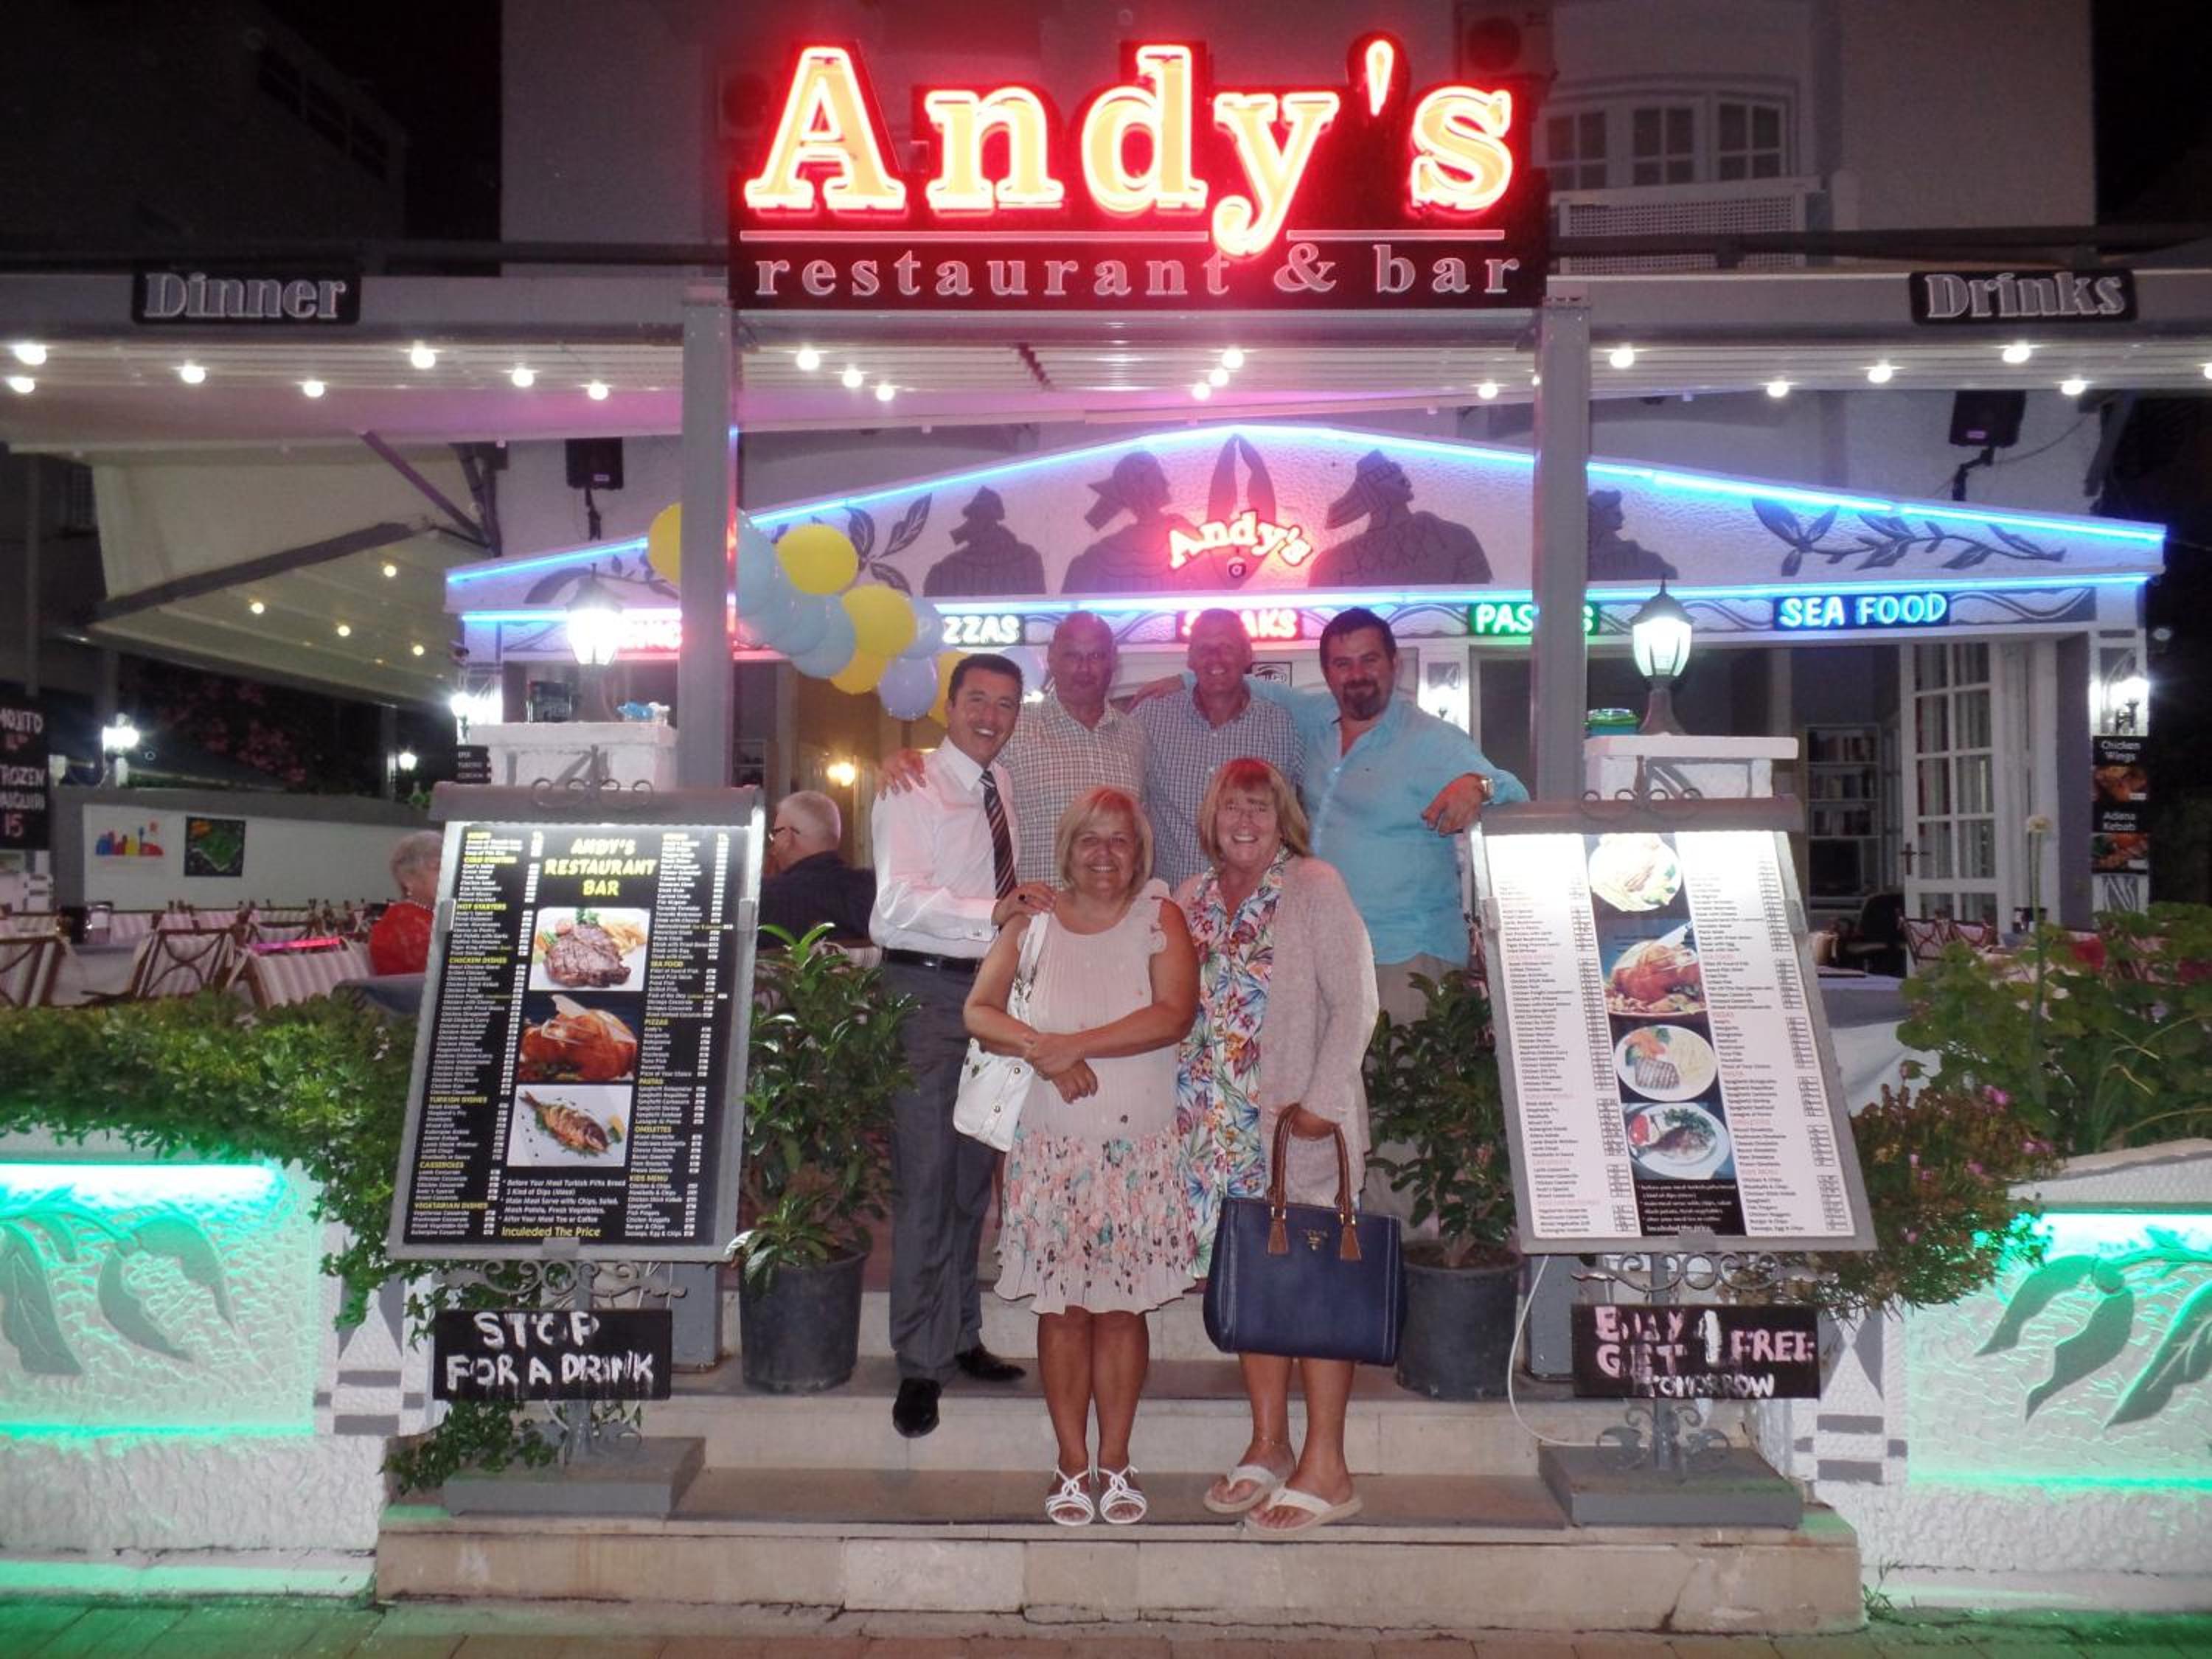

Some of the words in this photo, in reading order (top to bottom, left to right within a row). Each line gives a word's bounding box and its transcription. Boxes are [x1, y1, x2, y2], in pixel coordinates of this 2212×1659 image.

[743, 38, 1514, 257] Andy's
[754, 248, 1231, 296] restaurant
[1273, 242, 1335, 294] &
[1374, 243, 1520, 295] bar
[143, 271, 347, 319] Dinner
[1924, 271, 2125, 319] Drinks
[1169, 510, 1312, 569] Andy's
[1778, 596, 1846, 627] SEA
[1856, 593, 1947, 625] FOOD
[942, 615, 1020, 644] ZZAS
[0, 764, 46, 786] ROZEN
[571, 838, 636, 856] ANDY'S
[544, 858, 657, 875] RESTAURANT
[582, 879, 619, 896] BAR
[555, 1227, 573, 1237] The
[576, 1227, 601, 1237] Price
[473, 1311, 600, 1350] STOP
[1694, 1309, 1722, 1364] 1
[1731, 1329, 1816, 1363] FREE
[446, 1354, 520, 1392] FOR
[529, 1356, 552, 1386] A
[561, 1350, 655, 1388] DRINK
